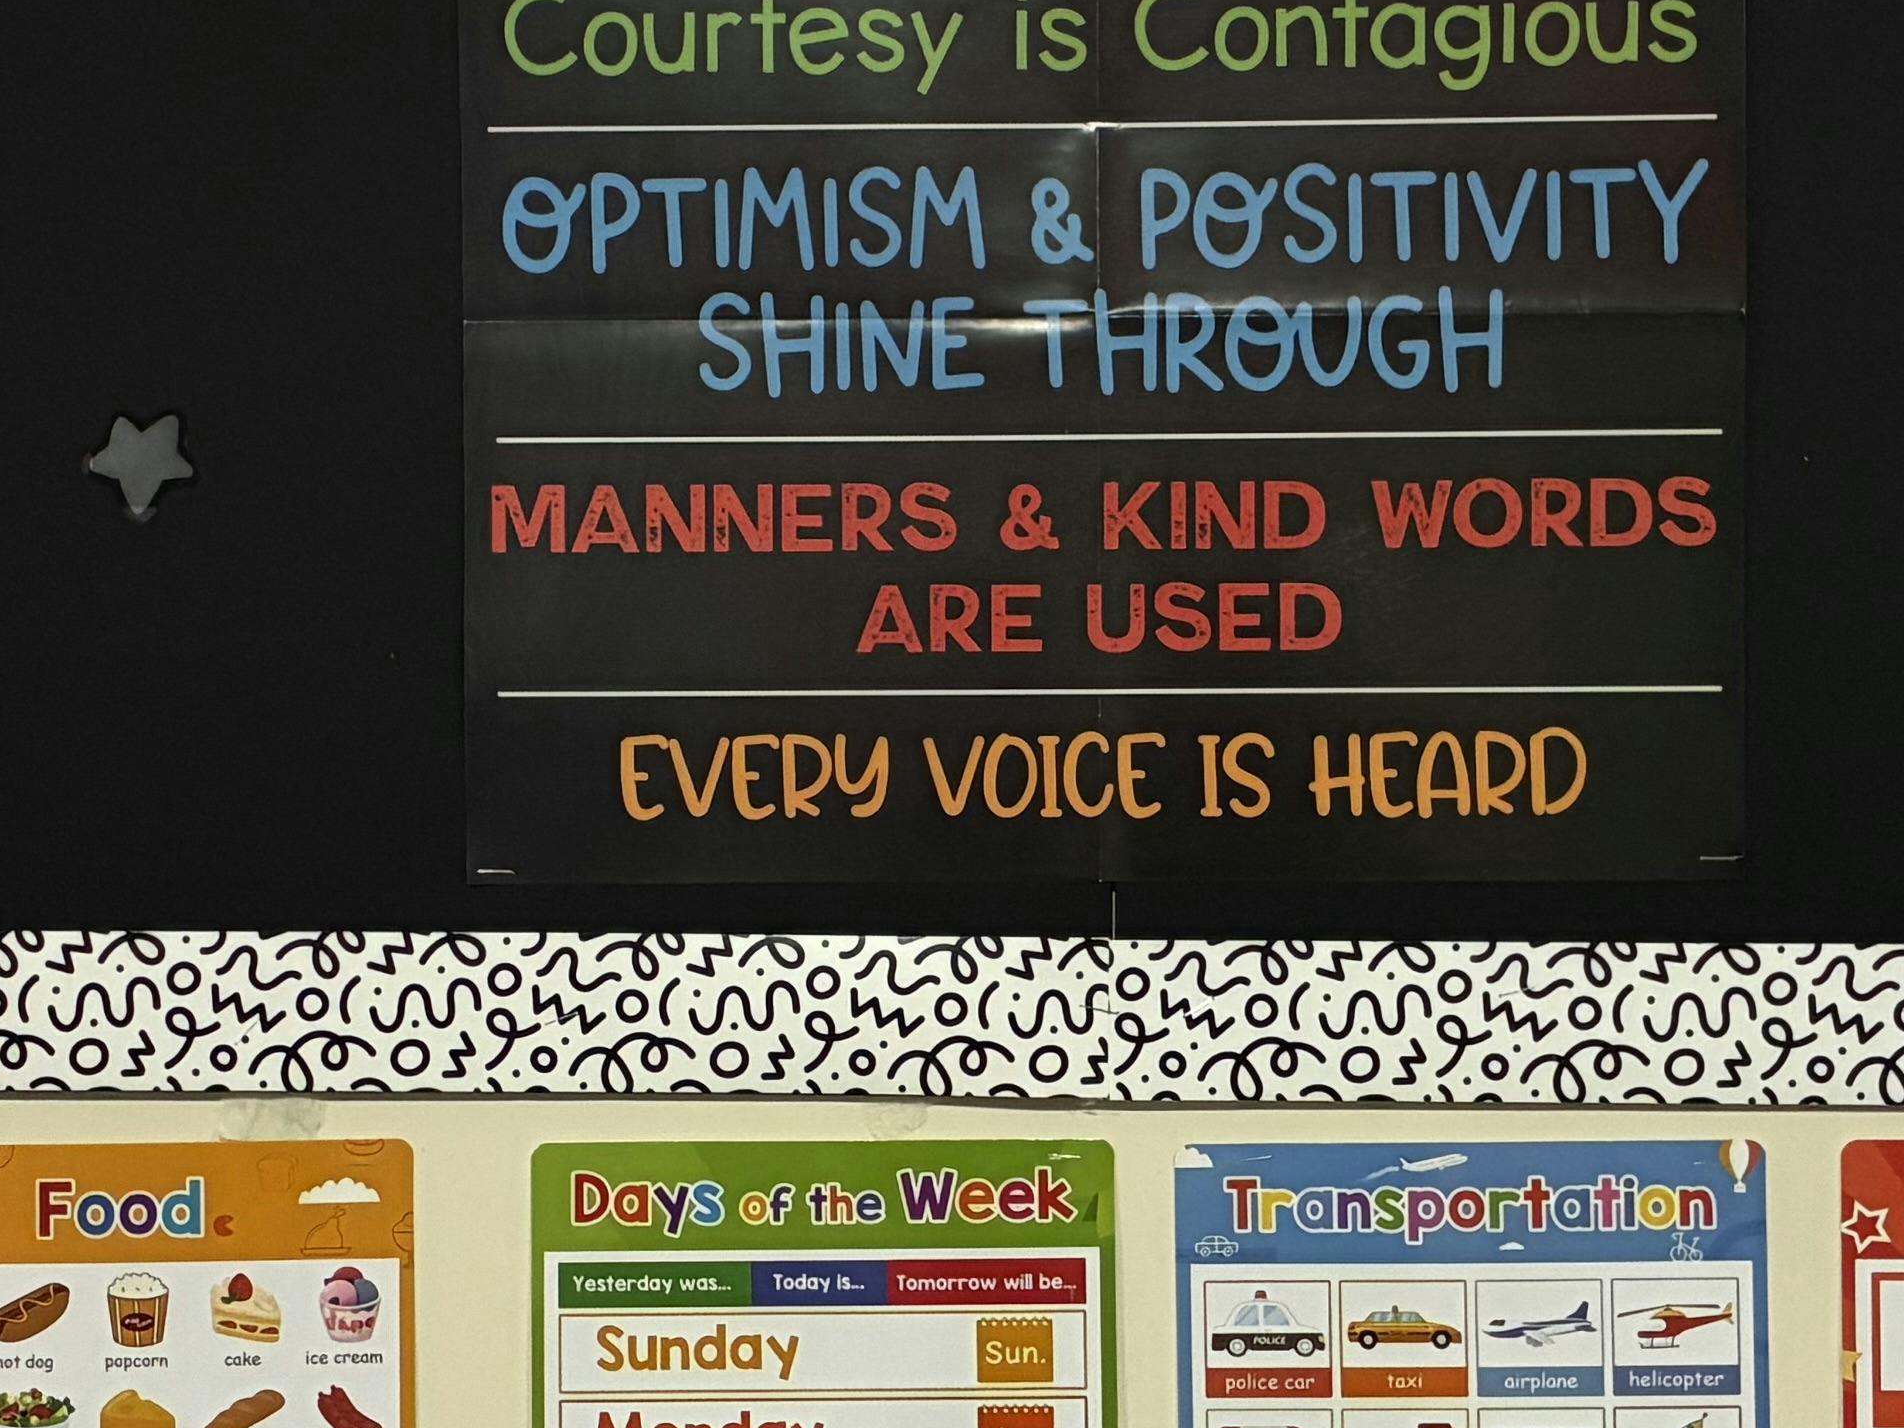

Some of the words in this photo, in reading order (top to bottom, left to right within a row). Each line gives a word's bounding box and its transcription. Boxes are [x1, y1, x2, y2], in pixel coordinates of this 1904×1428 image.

[501, 165, 989, 274] OPTIMISM
[1029, 175, 1095, 263] &
[1139, 157, 1708, 270] POSITIVITY
[697, 289, 988, 397] SHINE
[1024, 285, 1506, 396] THROUGH
[490, 482, 958, 554] MANNERS
[1000, 482, 1056, 552] &
[1103, 479, 1327, 550] KIND
[1372, 475, 1718, 549] WORDS
[855, 582, 1045, 654] ARE
[1086, 579, 1343, 652] USED
[618, 731, 888, 821] EVERY
[923, 731, 1164, 819] VOICE
[1199, 731, 1273, 819] IS
[1308, 724, 1588, 819] HEARD
[36, 1176, 205, 1241] Food
[571, 1170, 724, 1237] Days
[739, 1184, 794, 1223] of
[810, 1182, 886, 1225] the
[898, 1166, 1078, 1223] Week
[1223, 1175, 1717, 1245] Transportation
[573, 1275, 672, 1293] Yesterday
[772, 1273, 830, 1292] Today
[896, 1273, 996, 1292] Tomorrow
[1003, 1274, 1034, 1291] will
[105, 1352, 169, 1371] popcorn
[305, 1350, 330, 1366] ice
[334, 1352, 383, 1365] cream
[596, 1324, 799, 1380] Sunday
[985, 1341, 1047, 1364] Sun.
[1253, 1336, 1286, 1344] POLICE
[1226, 1373, 1278, 1394] police
[1285, 1377, 1314, 1390] car
